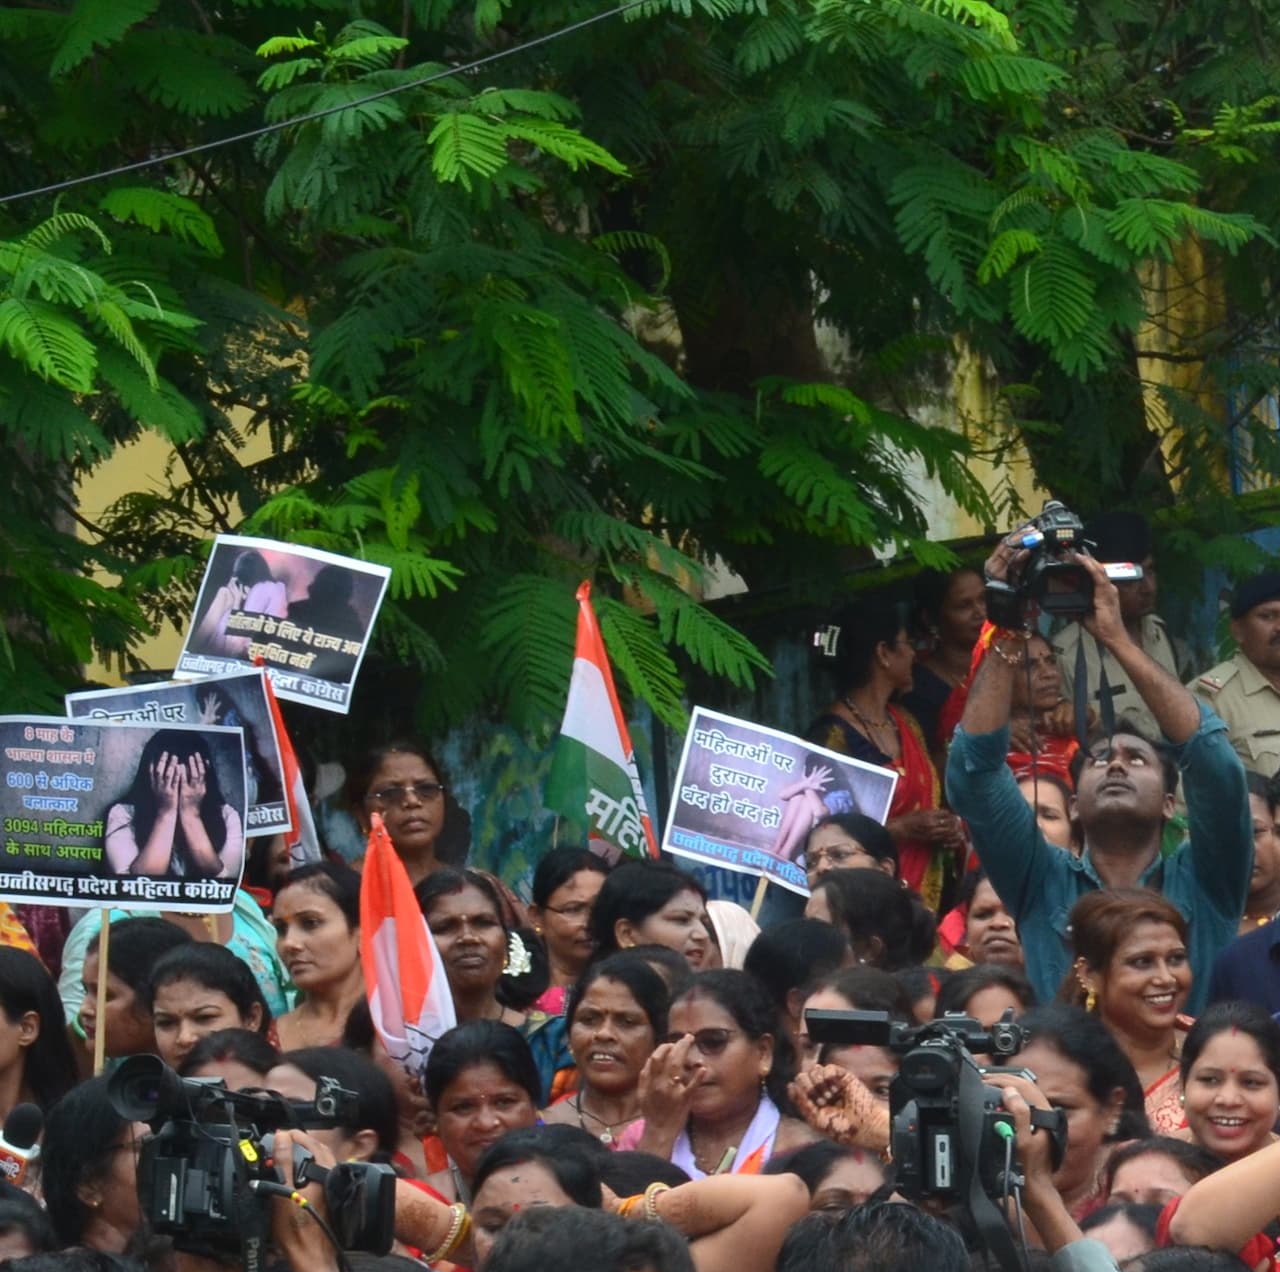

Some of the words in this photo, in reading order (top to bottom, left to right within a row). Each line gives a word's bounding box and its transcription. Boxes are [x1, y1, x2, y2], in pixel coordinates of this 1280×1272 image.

[276, 620, 302, 643] लिए
[313, 634, 344, 652] राज्य
[288, 651, 317, 670] नहीं
[300, 680, 345, 702] कांग्रेस
[162, 703, 185, 721] पर
[60, 725, 75, 743] के
[694, 728, 772, 764] महिलाओं
[771, 752, 794, 773] पर
[6, 771, 34, 789] 600
[35, 769, 49, 790] से
[50, 772, 94, 792] अधिक
[710, 764, 768, 793] दुराचार
[681, 784, 708, 809] बंद
[710, 791, 731, 815] हो
[734, 798, 760, 823] बंद
[761, 807, 782, 828] हो
[4, 818, 39, 833] 3094
[43, 817, 104, 839] महिलाओं
[5, 838, 20, 856] के
[23, 843, 52, 858] साथ
[55, 846, 103, 861] अपराध
[78, 875, 119, 897] प्रदेश
[121, 876, 182, 900] महिला
[184, 881, 235, 900] कांग्रेस
